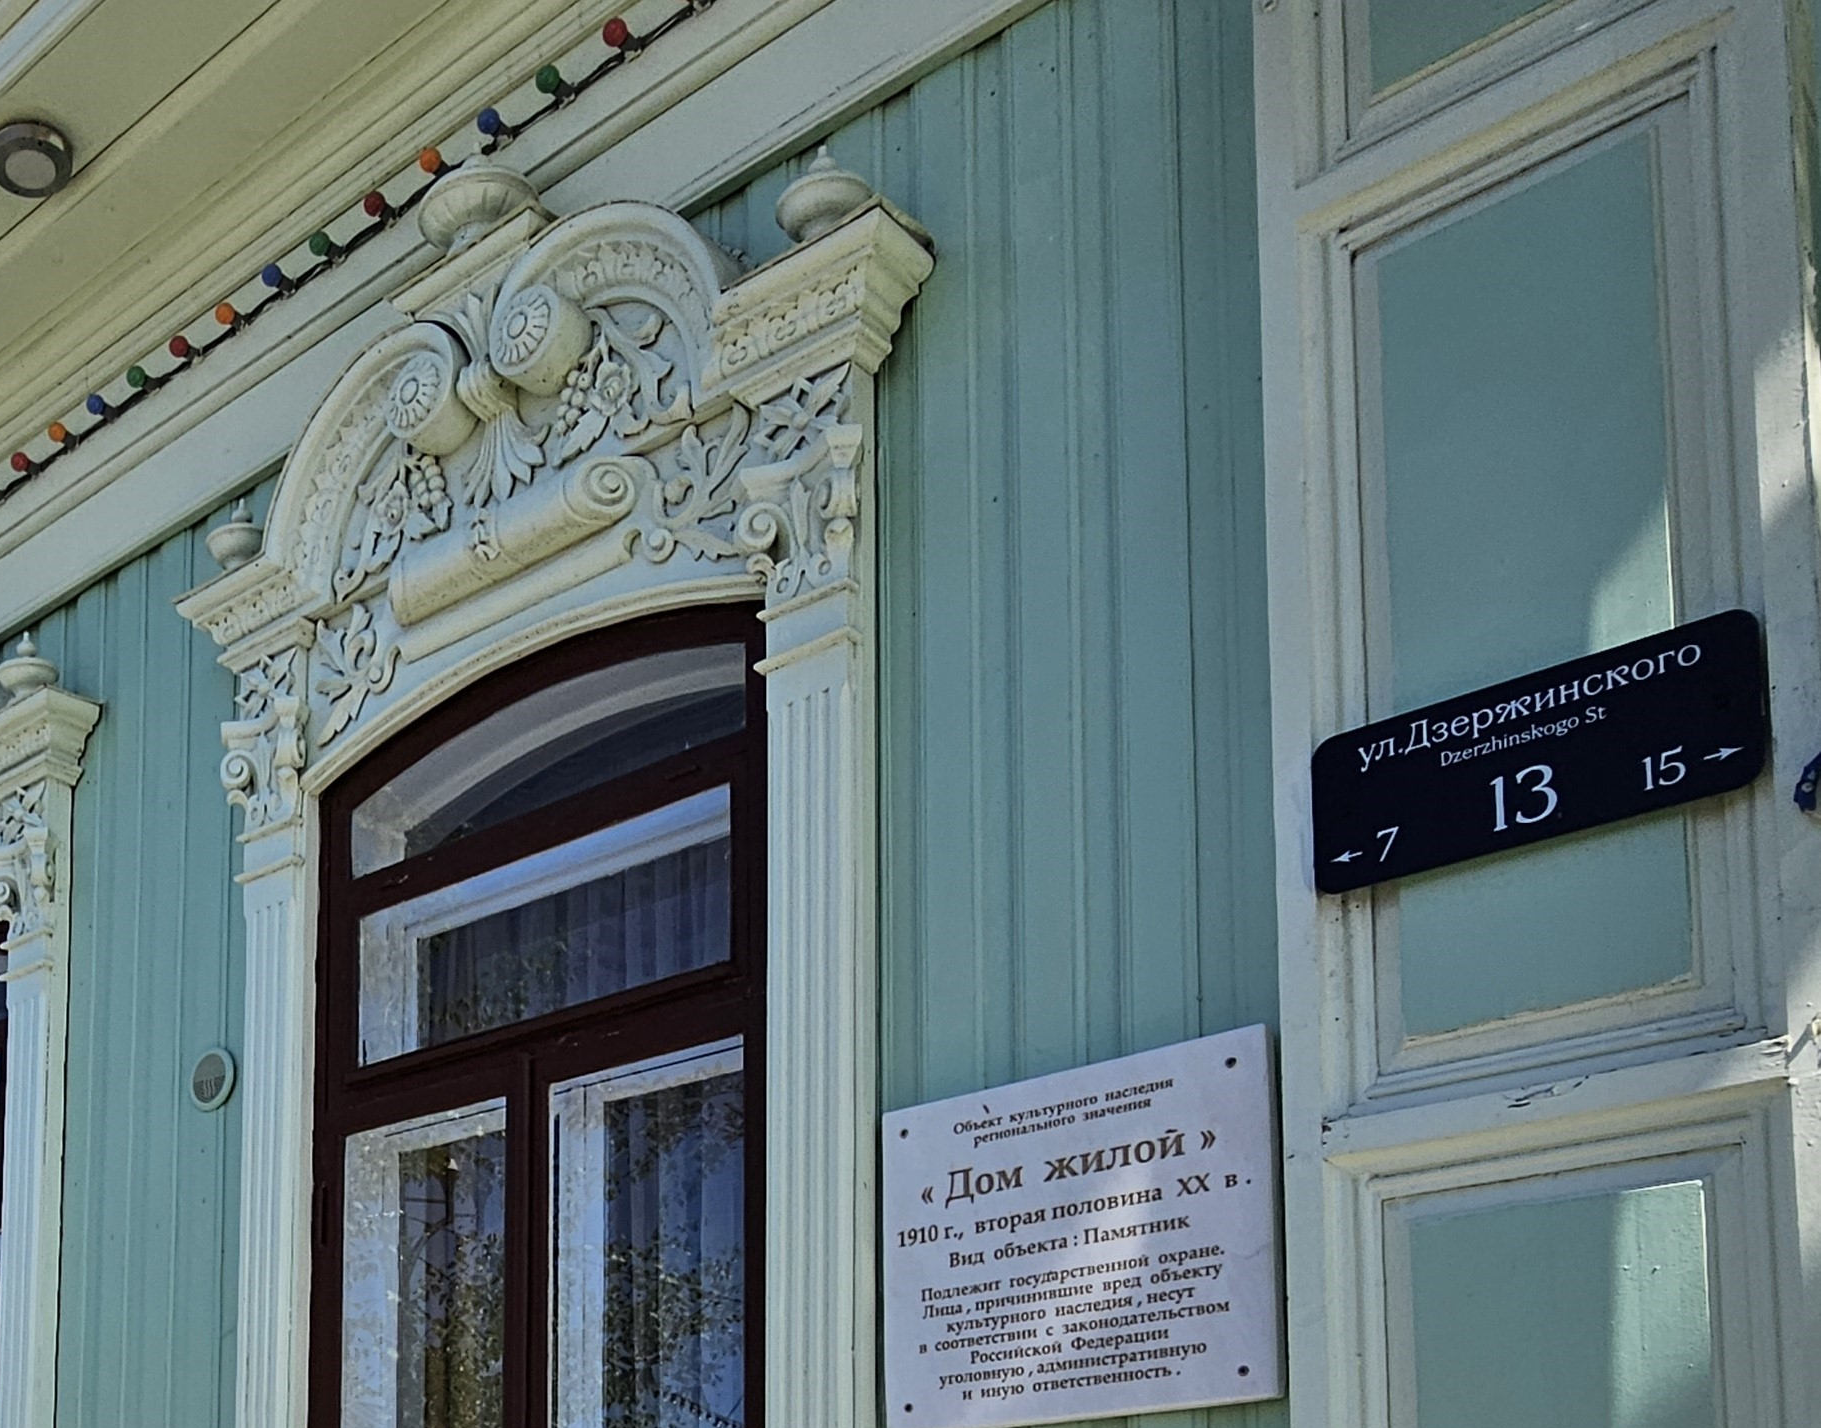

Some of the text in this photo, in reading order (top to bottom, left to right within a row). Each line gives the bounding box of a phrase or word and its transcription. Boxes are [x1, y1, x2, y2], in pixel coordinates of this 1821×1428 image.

[1440, 705, 1608, 767] Dzerzhinskogo St
[1641, 746, 1687, 791] 15
[1489, 764, 1558, 832] 13
[1376, 826, 1399, 862] 7
[953, 1077, 1174, 1135] Объект культурного наследия
[972, 1099, 1152, 1148] регионального значения
[897, 1224, 939, 1249] 1910
[974, 1209, 1046, 1236] вторая
[1052, 1189, 1163, 1220] половина
[948, 1251, 985, 1269] Вид
[1083, 1215, 1191, 1246] Памятник
[920, 1244, 1225, 1303] Подлежит государственной охране.
[975, 1282, 1093, 1313] причинившие
[1102, 1274, 1142, 1294] вред
[1151, 1263, 1223, 1287] объекту
[919, 1299, 1230, 1354] в соответствии с законодательством
[946, 1308, 1046, 1334] культурного
[1146, 1286, 1196, 1306] несут
[970, 1327, 1169, 1366] Российской Федерации
[1037, 1340, 1207, 1375] административную
[963, 1388, 973, 1401] и
[981, 1382, 1024, 1399] иную
